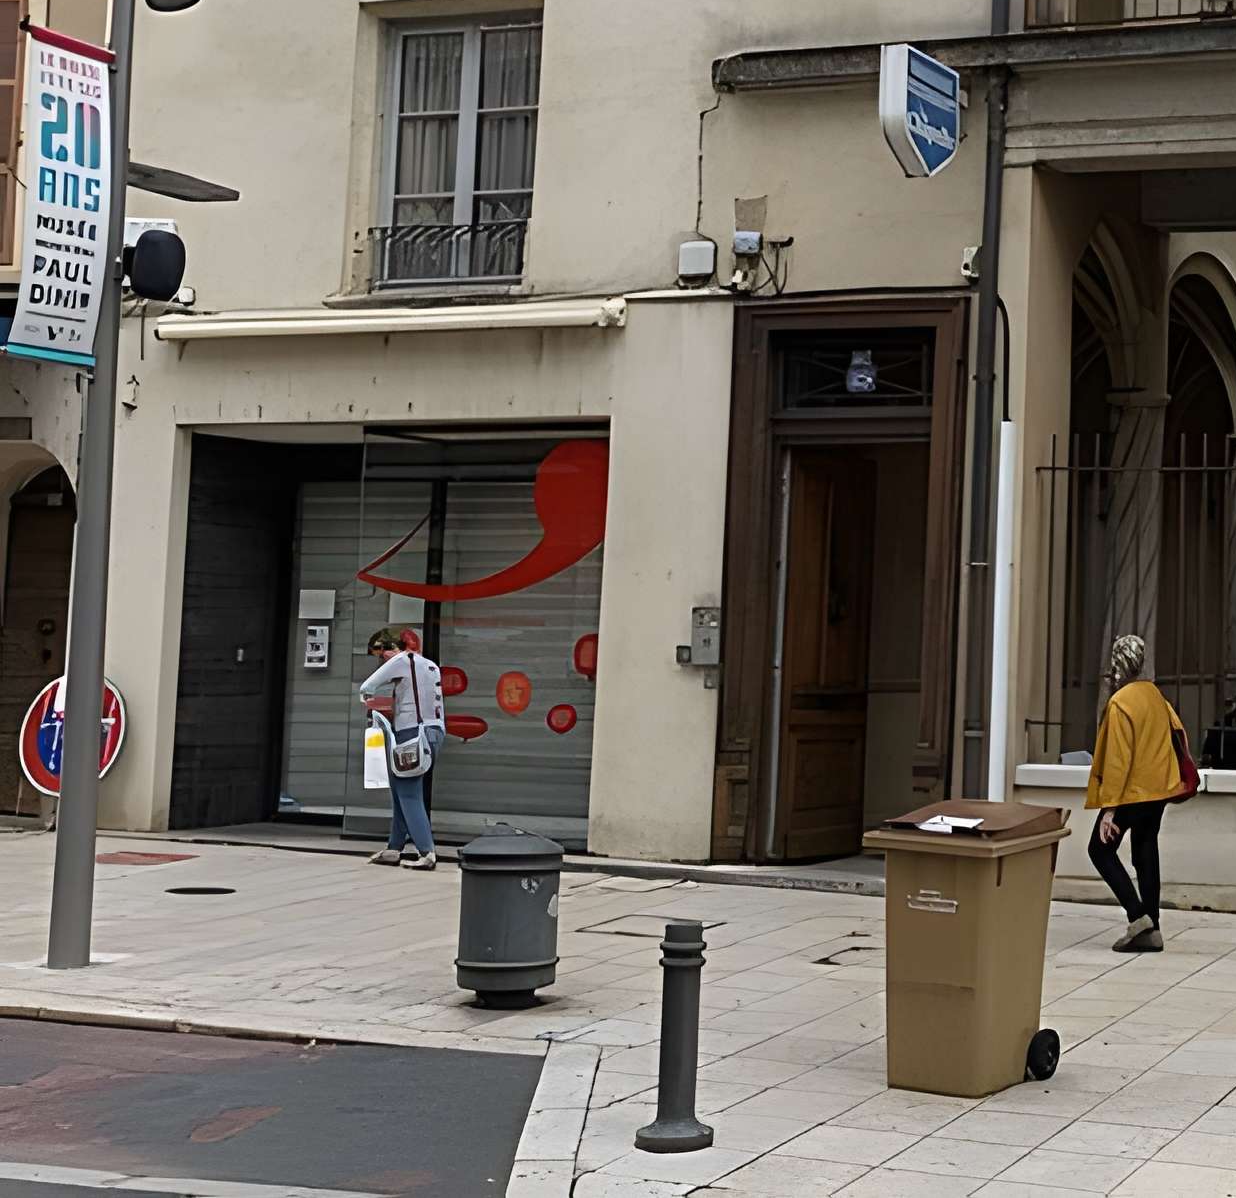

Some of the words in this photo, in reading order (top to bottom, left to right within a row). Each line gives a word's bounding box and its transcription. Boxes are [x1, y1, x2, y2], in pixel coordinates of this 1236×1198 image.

[40, 92, 101, 170] 20
[39, 166, 101, 213] ANS
[32, 254, 92, 286] PAUL
